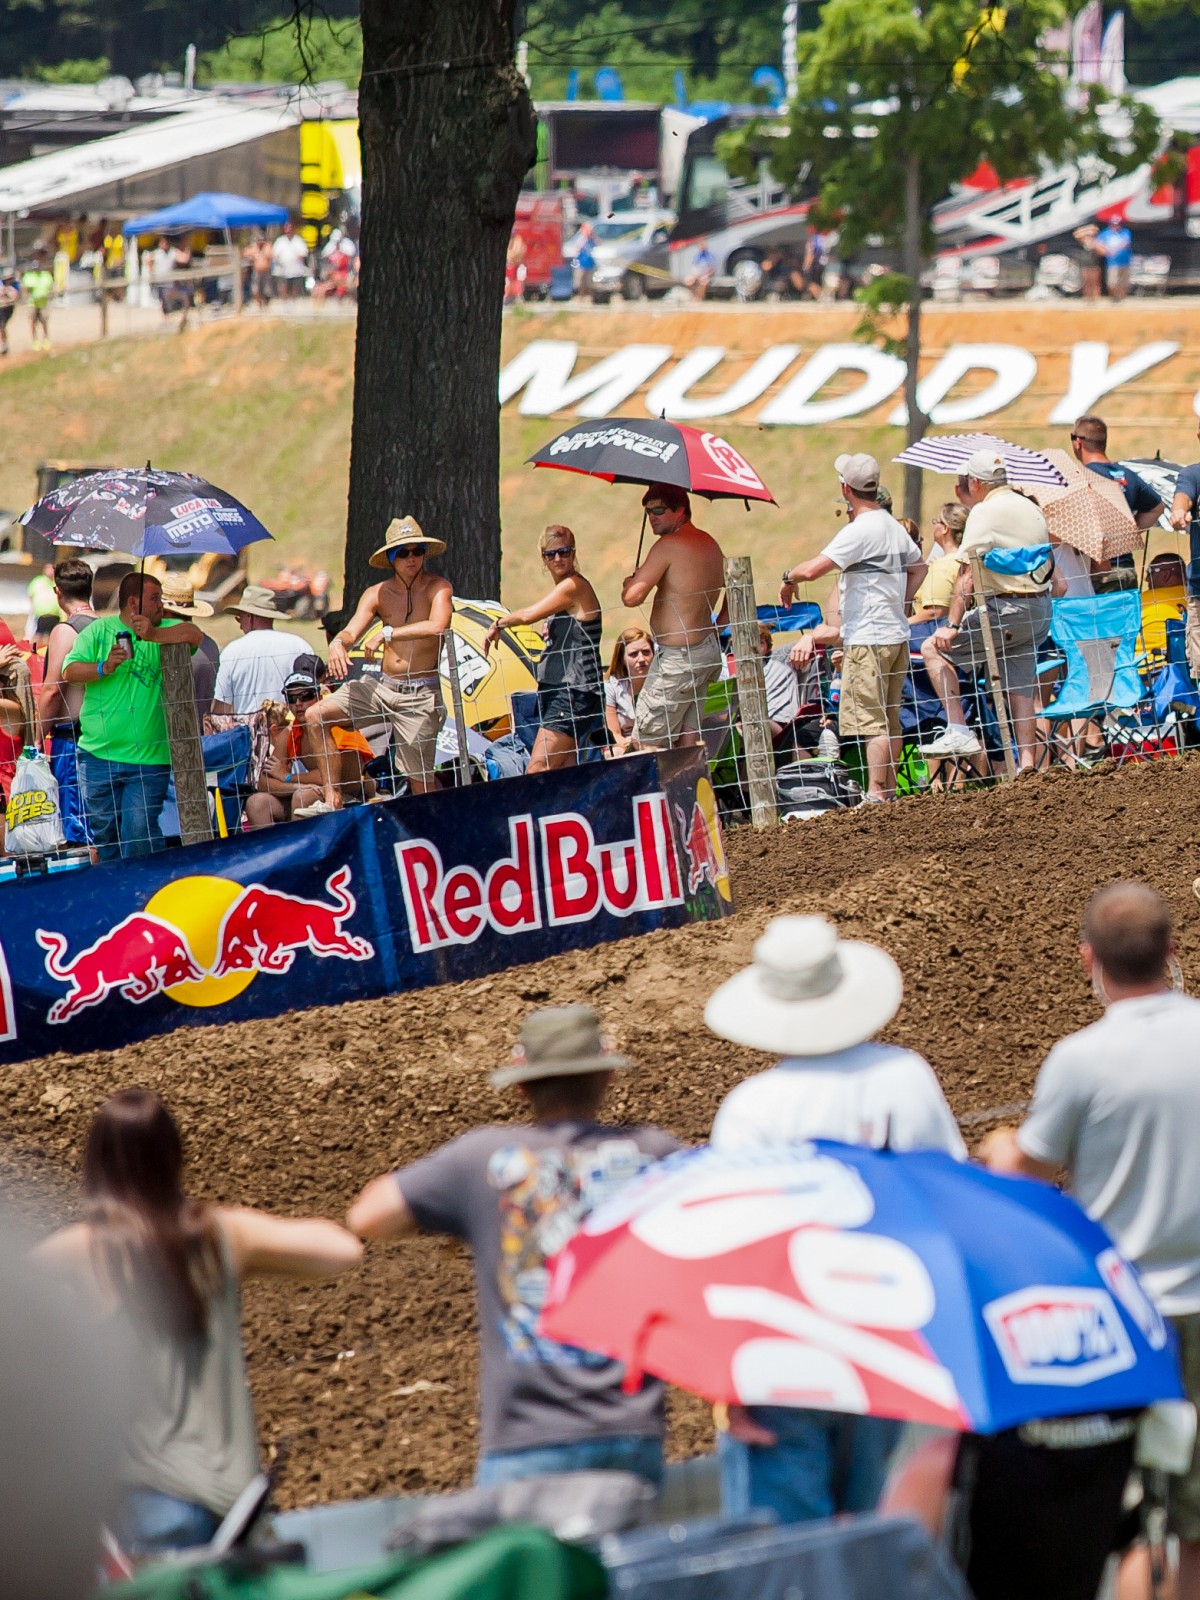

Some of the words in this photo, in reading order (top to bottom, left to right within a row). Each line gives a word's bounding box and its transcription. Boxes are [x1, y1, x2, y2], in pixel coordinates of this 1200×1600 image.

[499, 339, 1180, 426] MUDDY
[573, 430, 605, 441] ROCKY
[605, 427, 668, 448] MOUNTAIN
[6, 800, 56, 831] TEES
[397, 815, 540, 950] Red
[540, 793, 683, 926] Bull
